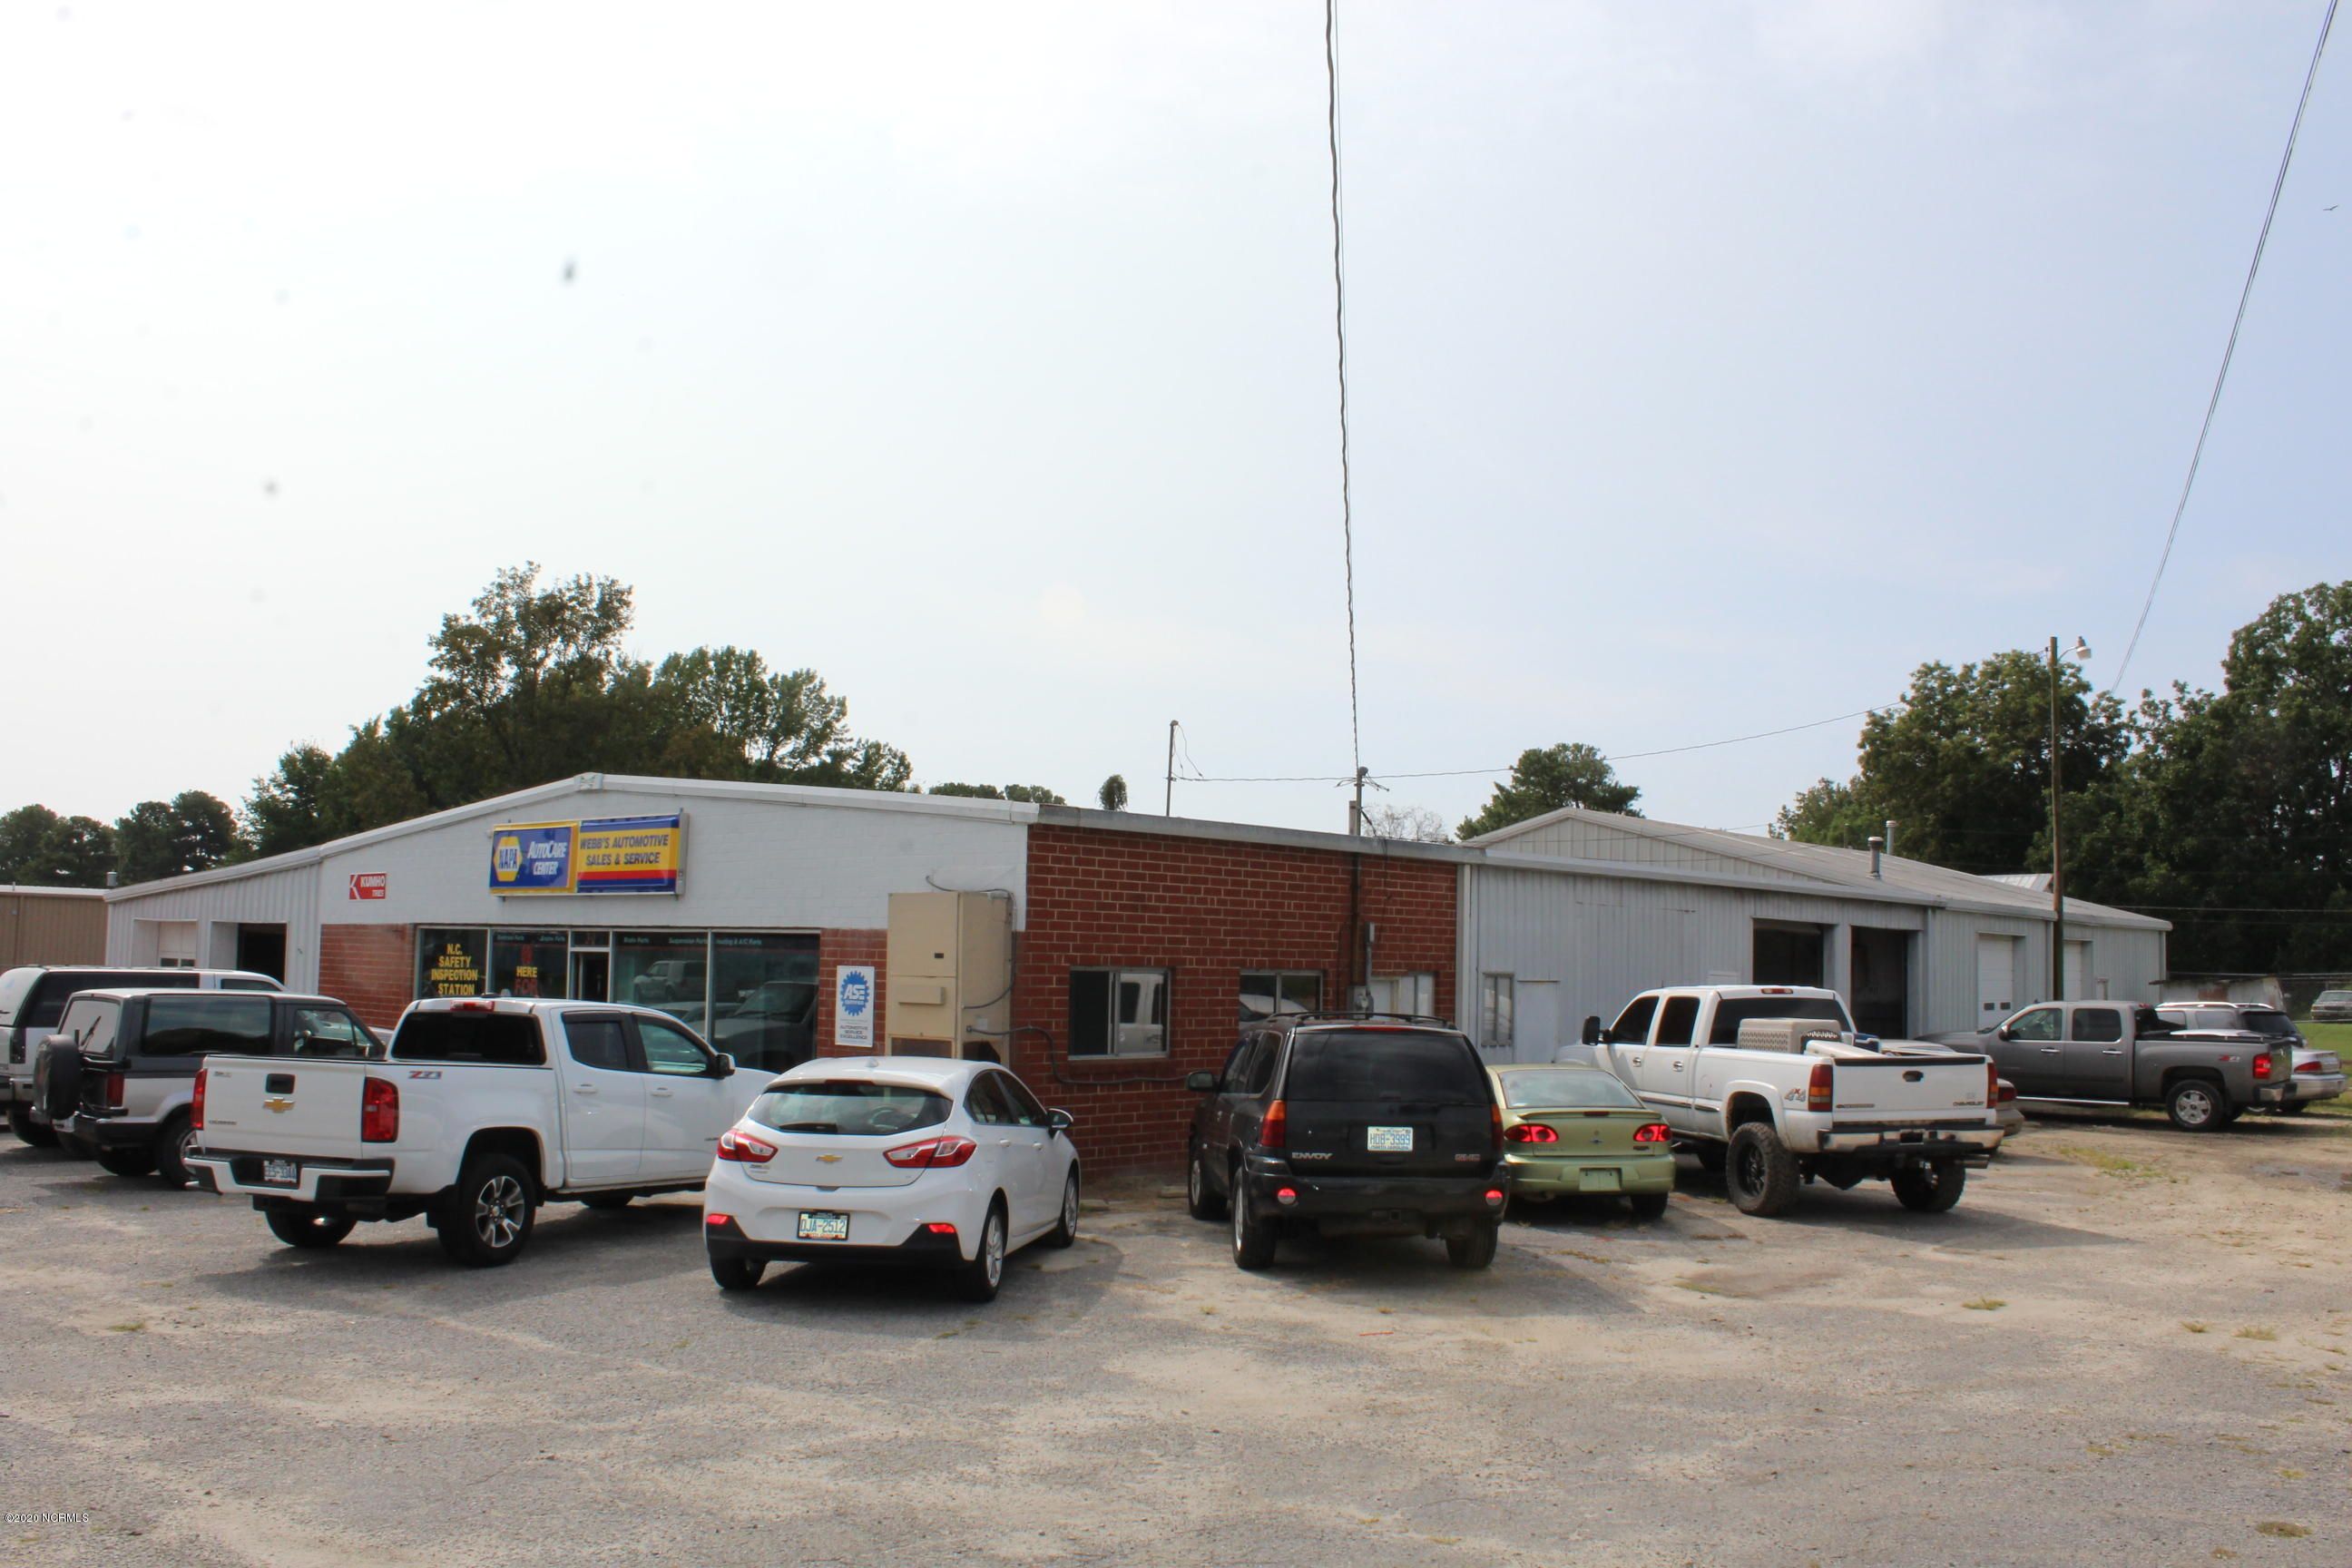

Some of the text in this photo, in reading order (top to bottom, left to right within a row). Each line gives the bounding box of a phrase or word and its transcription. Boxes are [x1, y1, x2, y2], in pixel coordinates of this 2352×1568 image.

[580, 834, 669, 849] WEBB'S AUTOMOTIVE
[499, 848, 518, 868] NAPA
[586, 852, 661, 866] SALES & SERVICE
[533, 861, 559, 876] CENTER
[360, 876, 386, 887] KUMHO
[447, 944, 463, 956] N.C.
[438, 956, 472, 968] SAFETY
[431, 969, 478, 981] INSPECTION
[516, 966, 537, 977] HERE
[437, 983, 475, 995] STATION
[844, 985, 866, 1000] ASE
[1291, 1152, 1334, 1161] ENVOY
[799, 1219, 846, 1233] DJA-2512
